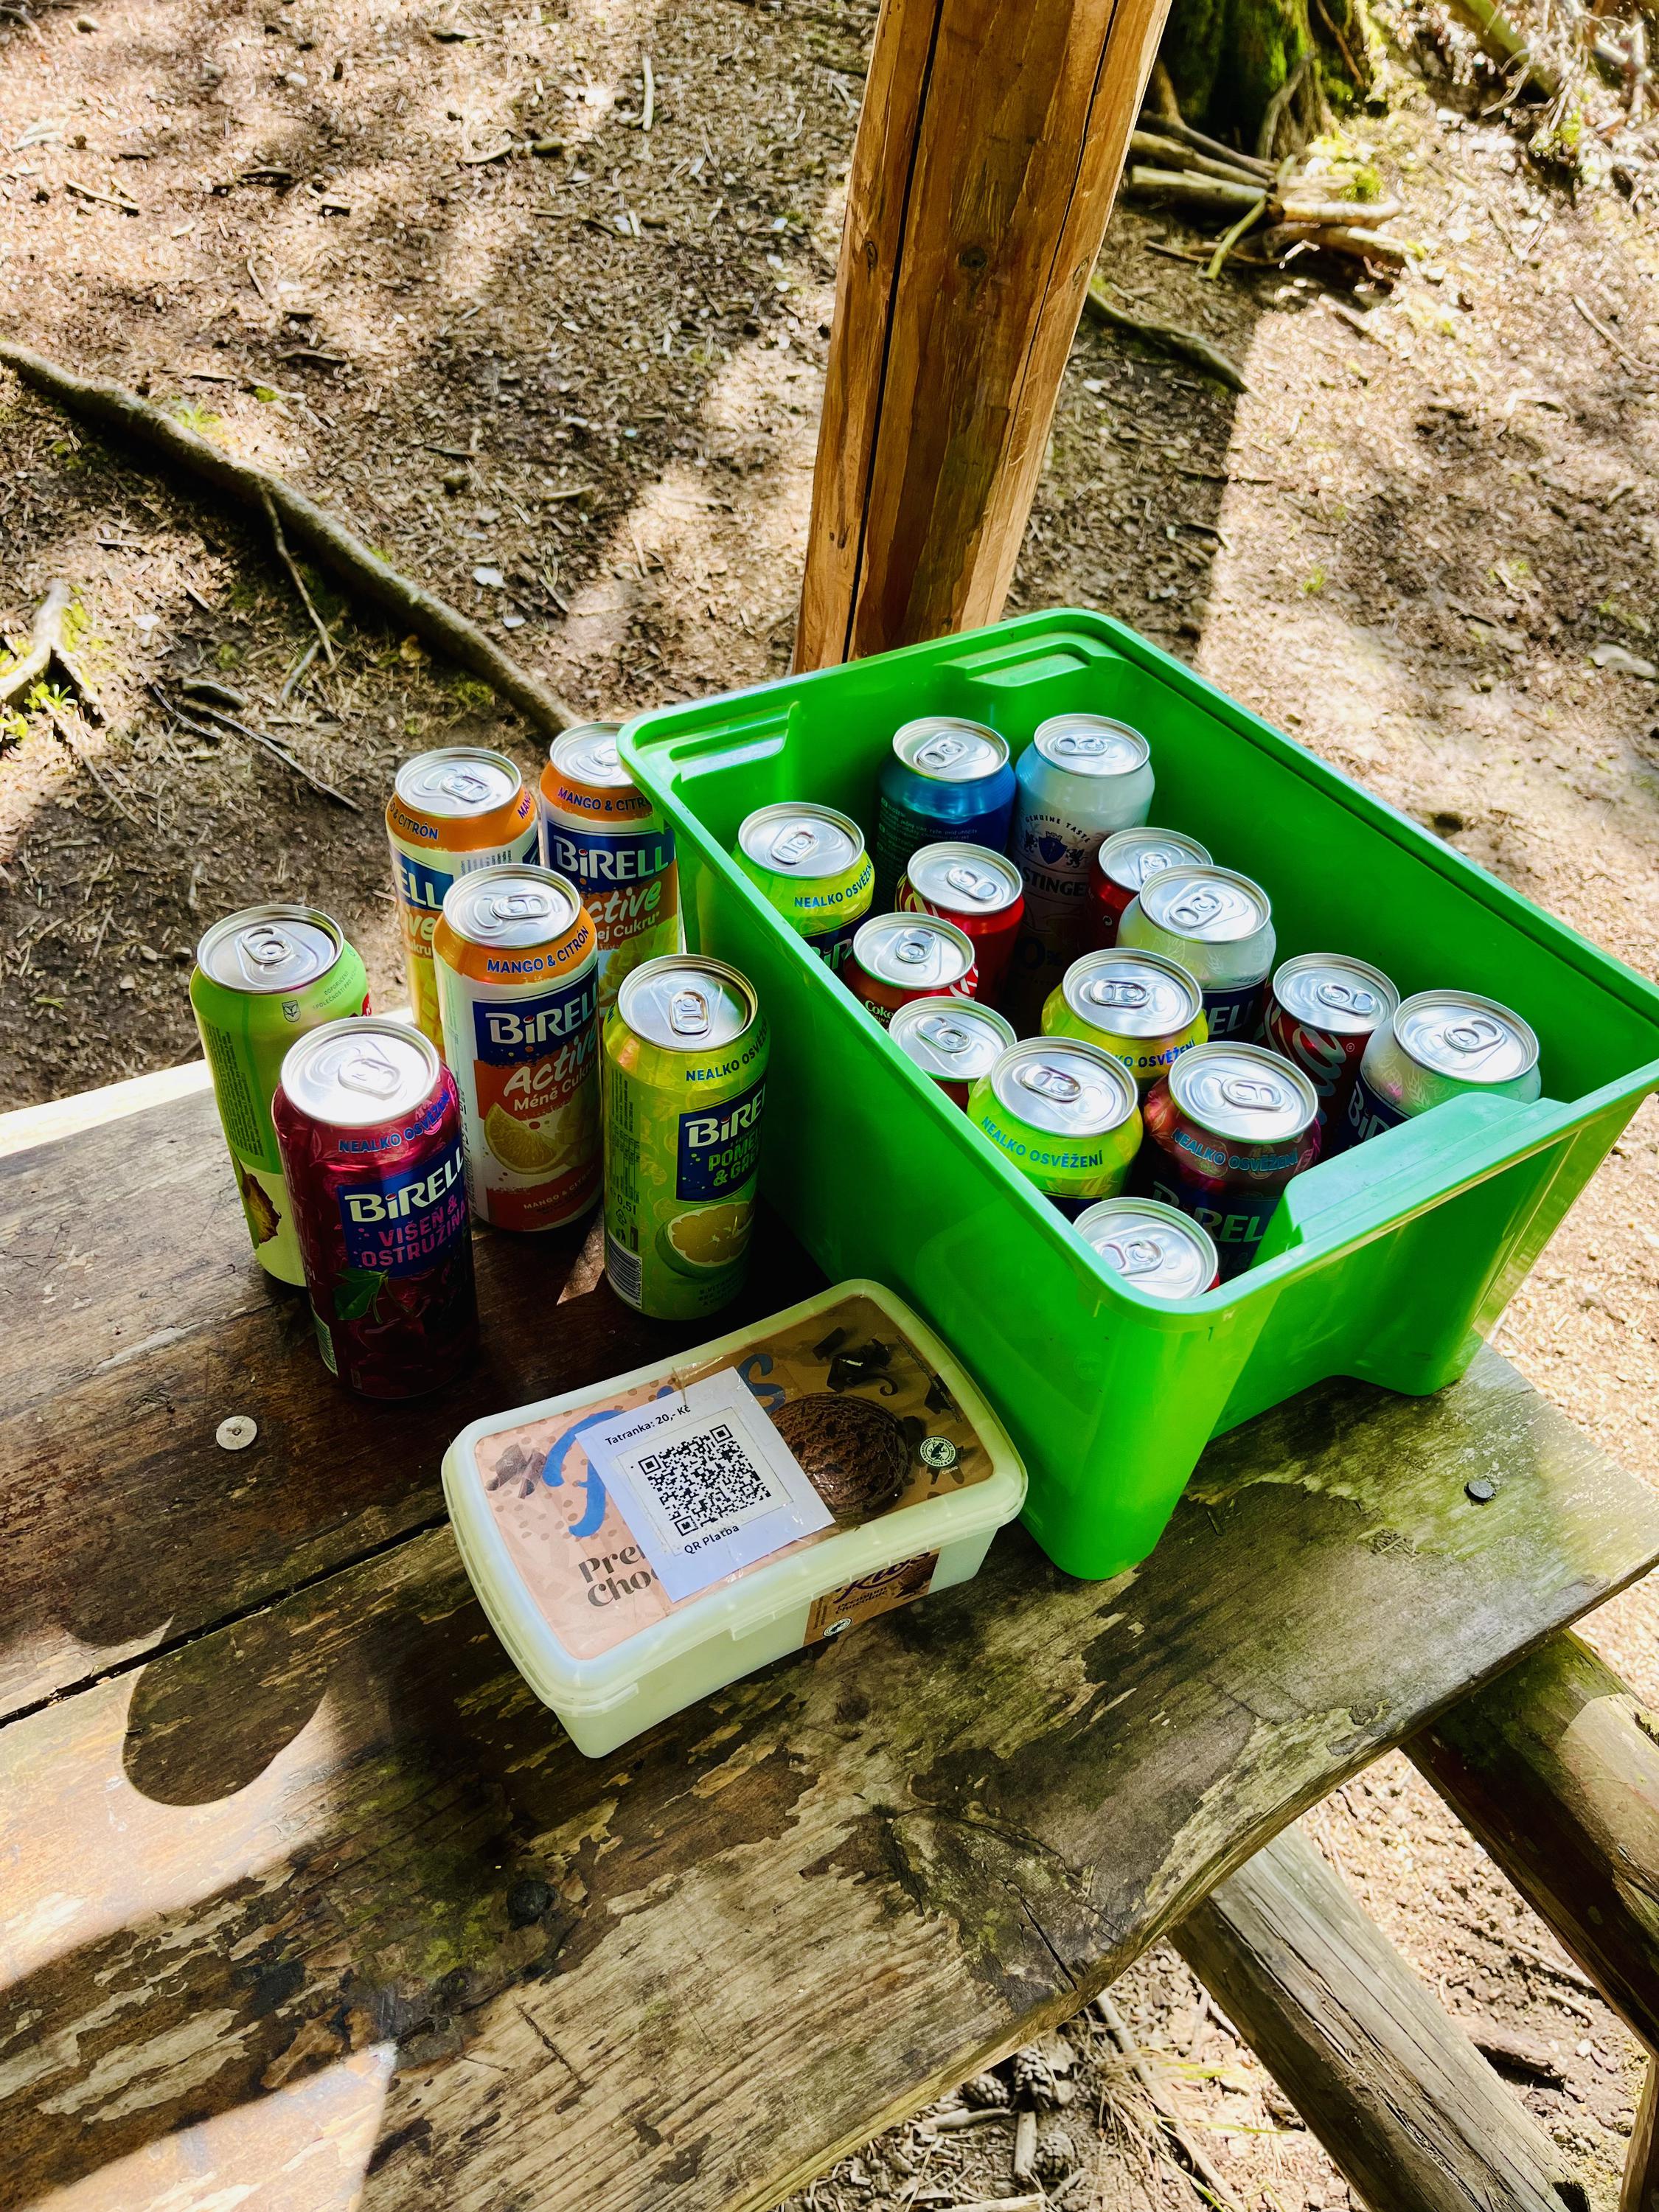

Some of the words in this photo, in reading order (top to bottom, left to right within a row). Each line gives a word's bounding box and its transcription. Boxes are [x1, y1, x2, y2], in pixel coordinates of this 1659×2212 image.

[558, 787, 601, 810] MANGO
[605, 801, 613, 811] &
[1066, 822, 1091, 843] TASTE
[581, 881, 662, 924] ctive
[794, 892, 844, 908] NEALKO
[487, 958, 544, 974] MANGO
[547, 955, 556, 967] &
[557, 925, 589, 962] CITRÓN
[865, 1000, 894, 1019] Coke
[686, 1060, 740, 1082] NEALKO
[514, 1088, 558, 1111] Méně
[338, 1133, 402, 1153] NEALKO
[980, 1116, 1026, 1156] NEALKO
[1029, 1150, 1103, 1169] OSVĚŽENÍ
[1170, 1127, 1226, 1166] NEALKO
[361, 1200, 466, 1267] OSTRUŽINA
[605, 1420, 655, 1447] Tatranka:
[677, 1404, 692, 1419] Kč
[684, 1540, 702, 1556] QR
[702, 1524, 740, 1546] Platba
[578, 1545, 647, 1583] Pre
